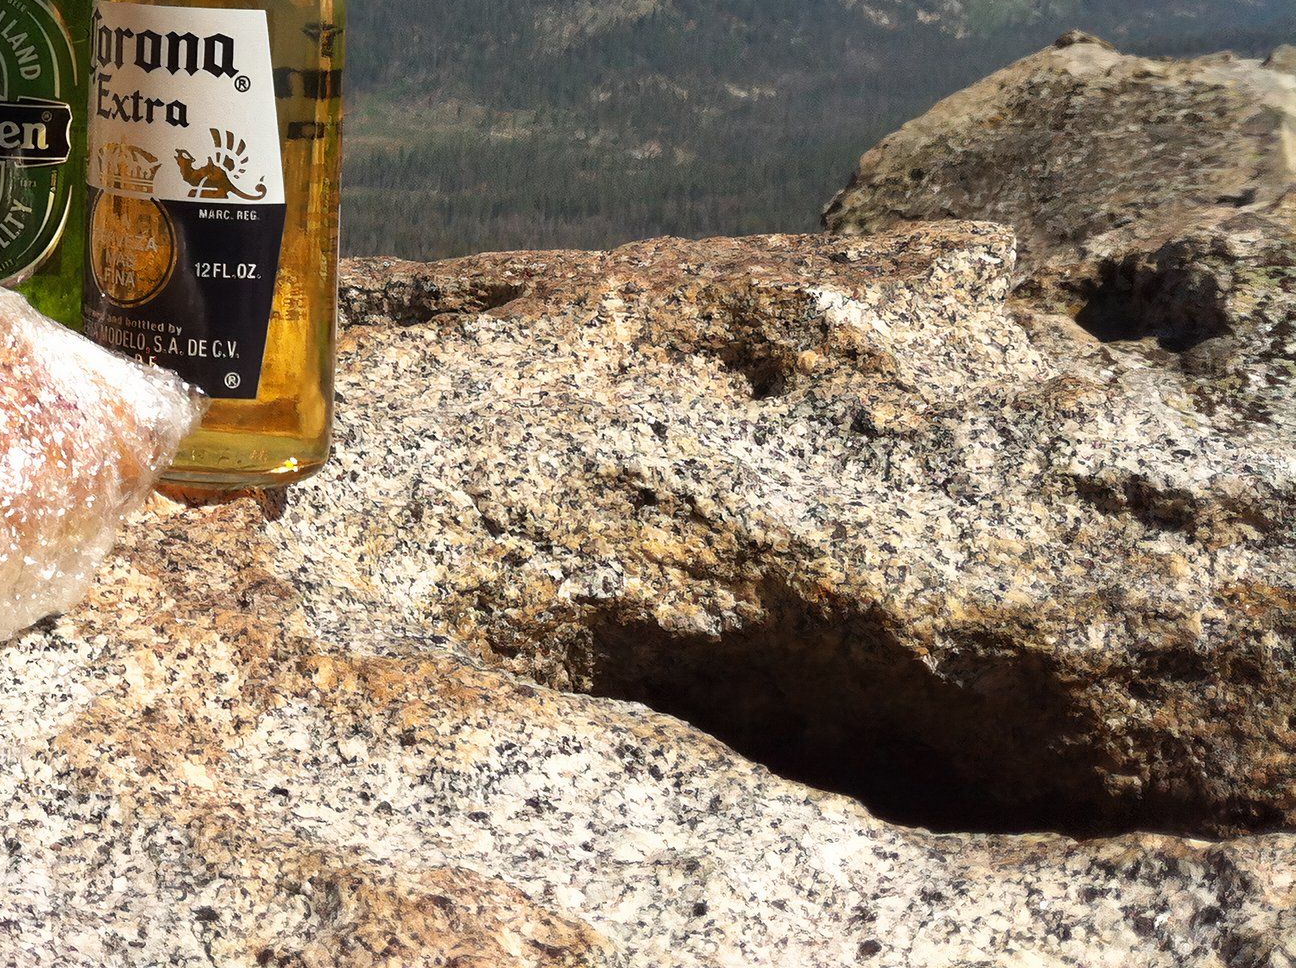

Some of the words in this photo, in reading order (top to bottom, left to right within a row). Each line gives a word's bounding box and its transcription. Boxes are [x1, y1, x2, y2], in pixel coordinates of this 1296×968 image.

[97, 73, 190, 128] Extra
[198, 209, 234, 220] MARC.
[104, 267, 135, 288] FINA
[106, 313, 123, 326] and
[125, 316, 164, 333] bottled
[168, 323, 182, 336] by
[187, 338, 207, 357] DE
[212, 339, 240, 359] C.V.
